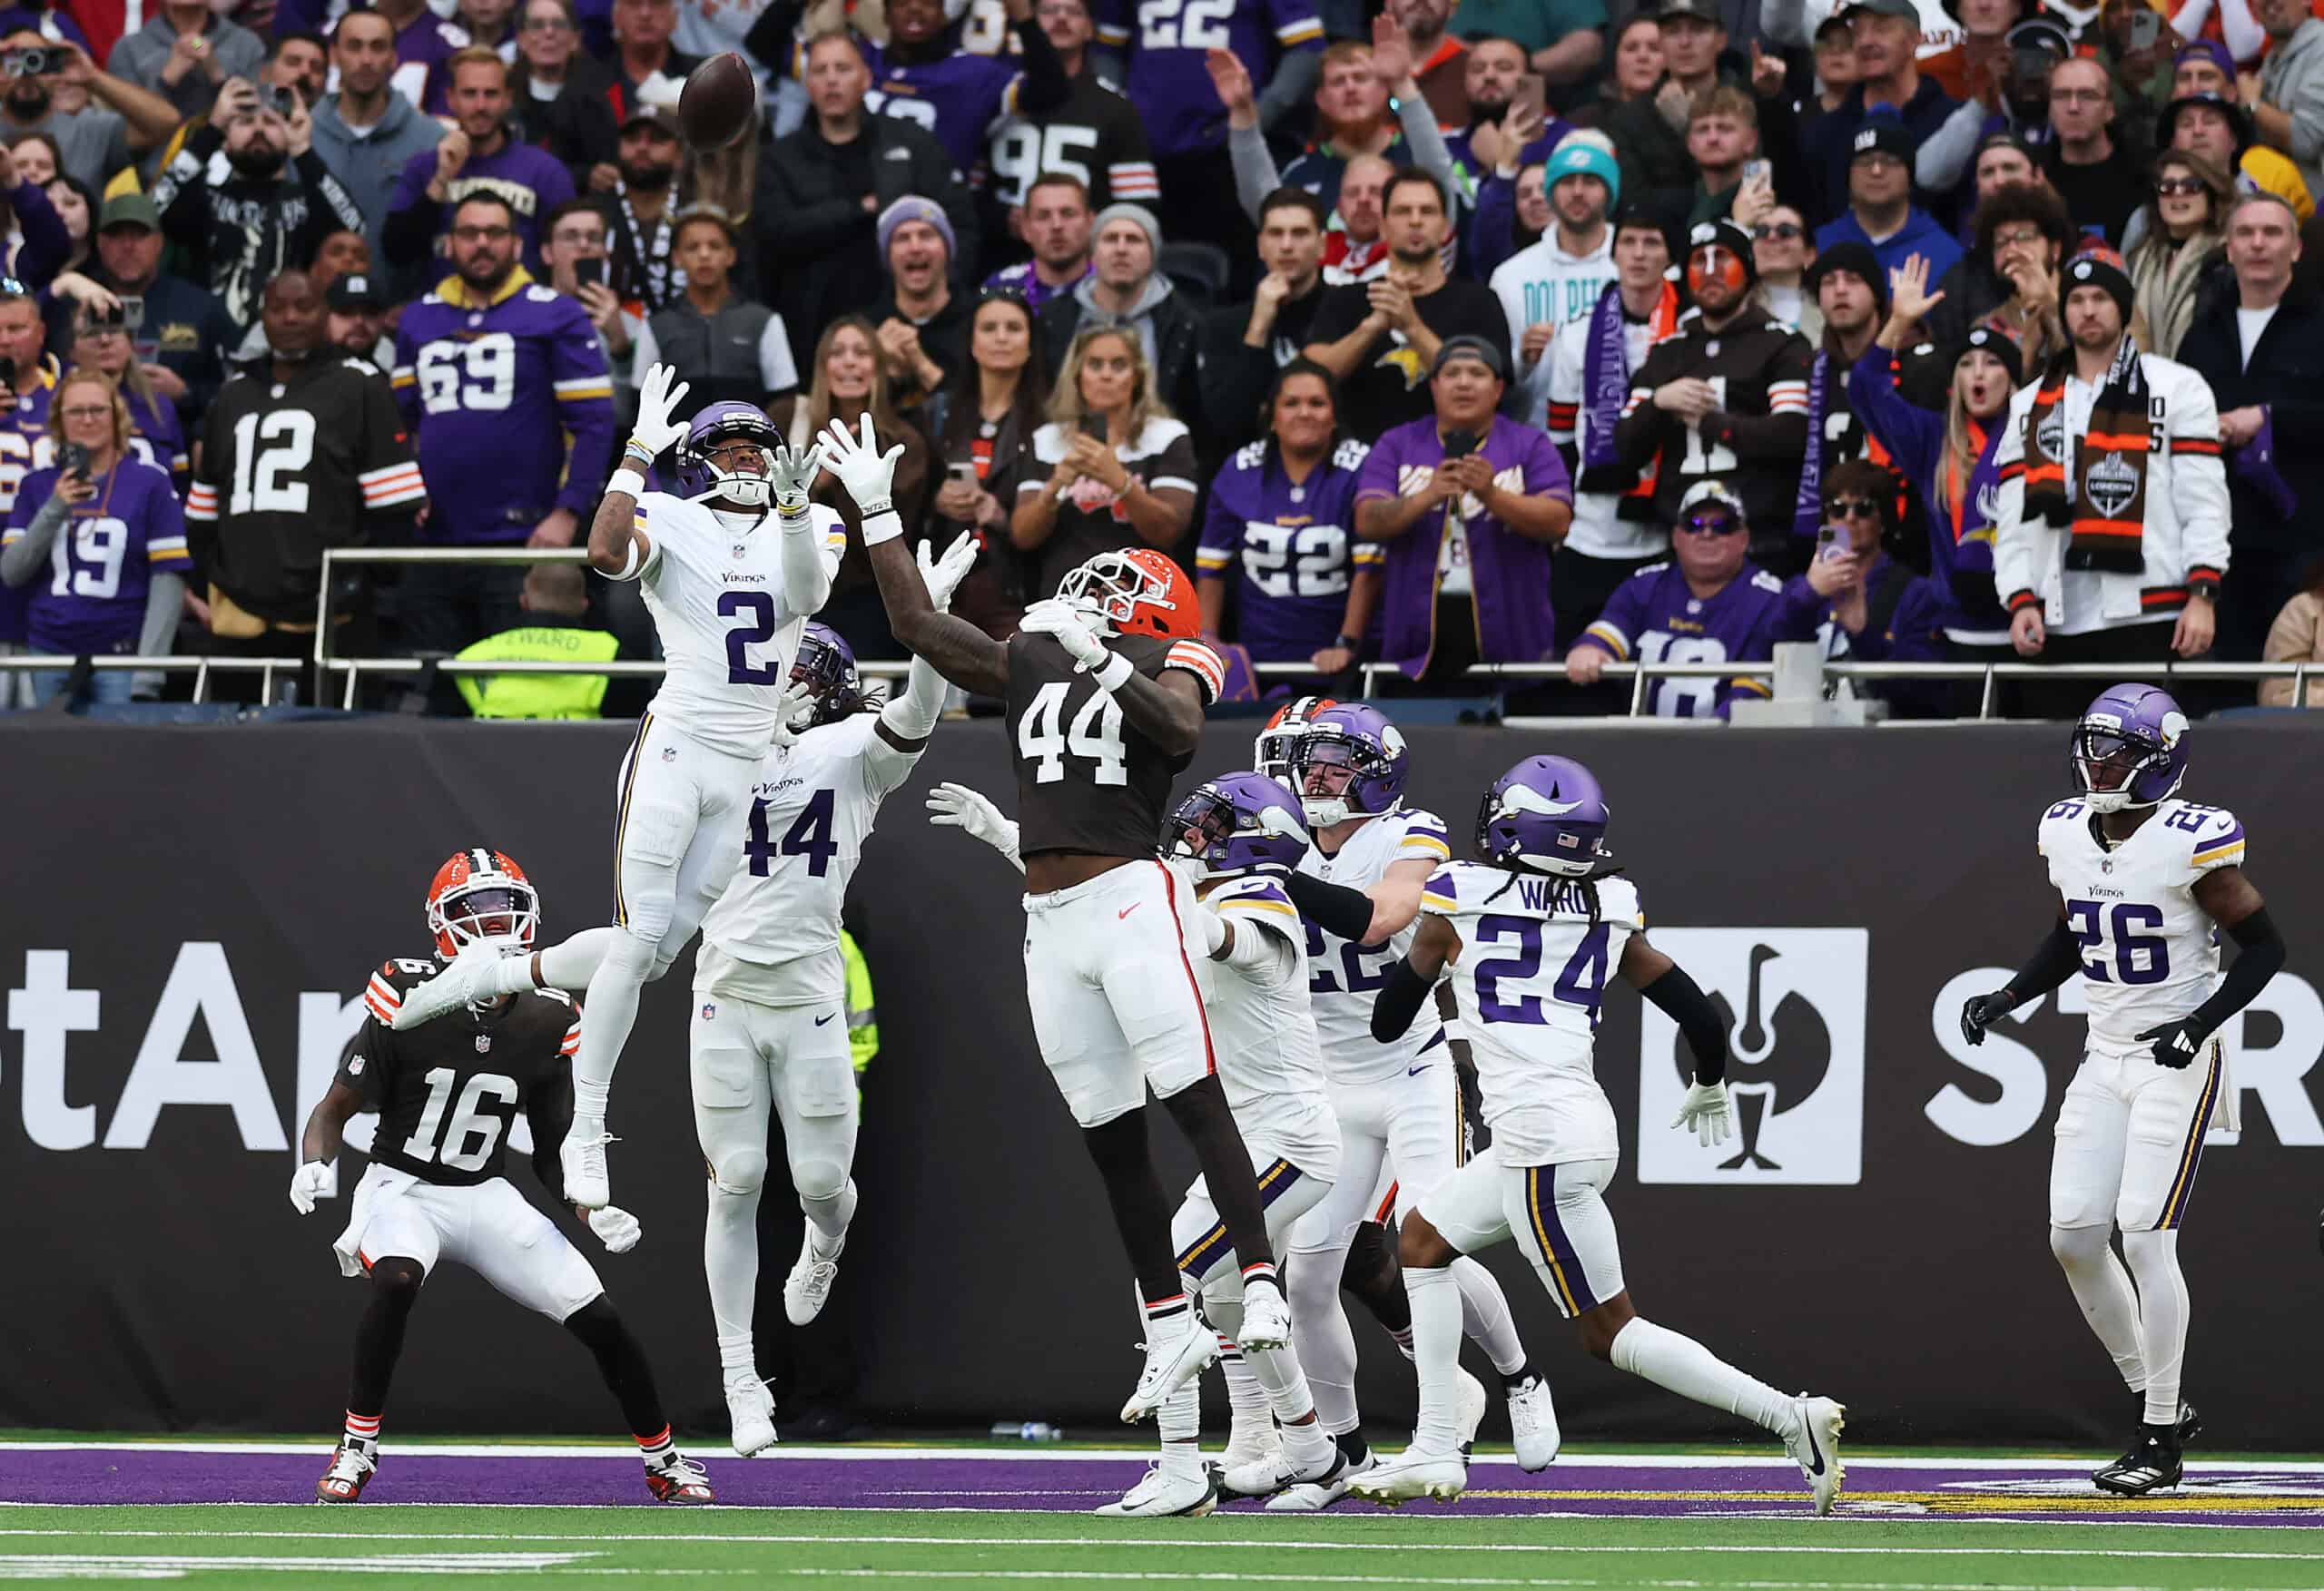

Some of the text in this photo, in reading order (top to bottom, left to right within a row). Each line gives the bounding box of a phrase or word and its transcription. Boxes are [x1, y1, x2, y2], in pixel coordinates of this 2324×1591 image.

[991, 123, 1098, 205] 95
[417, 332, 516, 415] 69
[230, 408, 317, 516] 12
[51, 517, 128, 599] 19
[1241, 520, 1349, 597] 22
[716, 591, 779, 686] 2
[1018, 682, 1128, 786] 44
[1518, 879, 1591, 915] WARD
[2067, 899, 2171, 985] 26
[1474, 914, 1610, 1031] 24
[1924, 967, 2324, 1147] SR
[403, 1066, 518, 1172] 16
